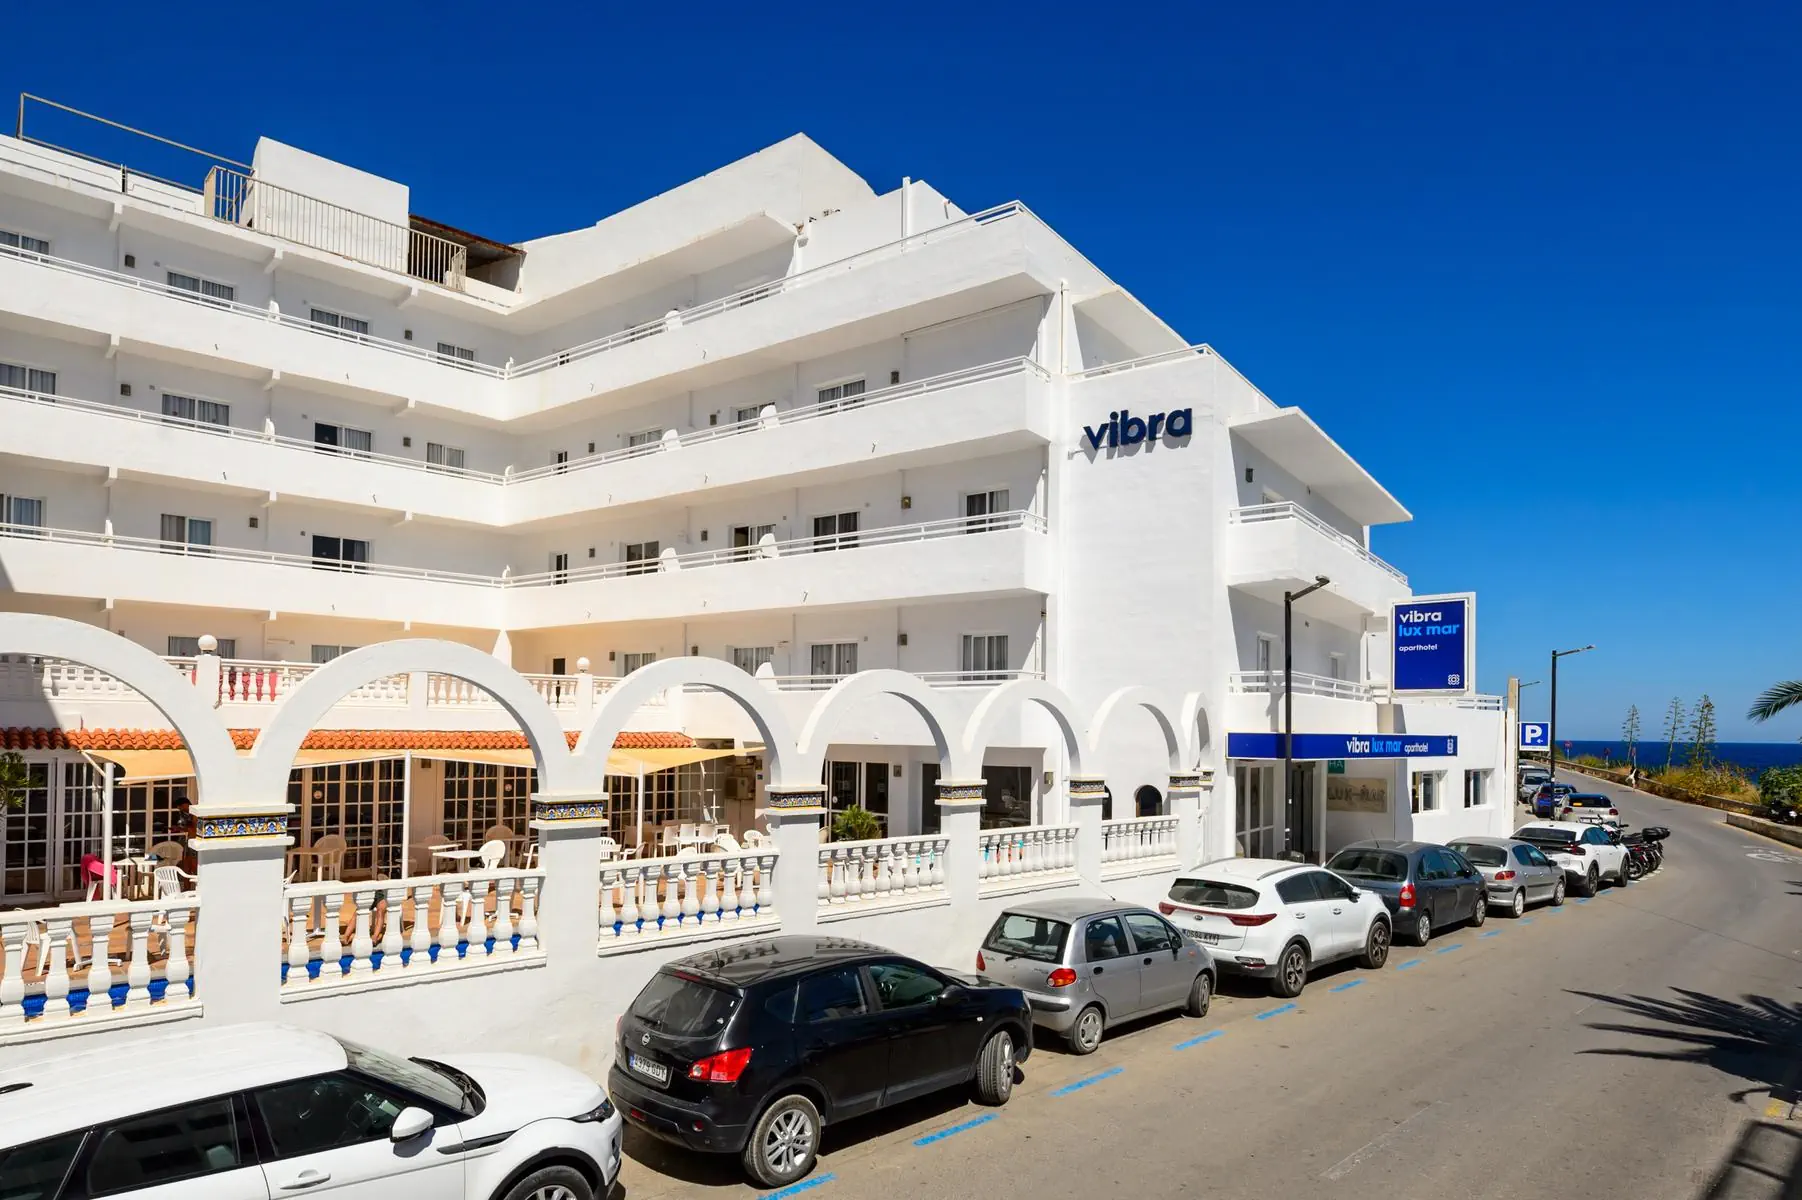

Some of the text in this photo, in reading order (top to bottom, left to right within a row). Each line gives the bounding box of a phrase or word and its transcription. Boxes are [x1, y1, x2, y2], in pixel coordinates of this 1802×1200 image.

[1083, 408, 1192, 451] vibra
[1399, 610, 1442, 623] vibra
[1398, 624, 1460, 637] lux mar
[1398, 644, 1438, 652] aparthotel
[1525, 725, 1542, 743] P
[1346, 737, 1428, 754] vibra lux mar aparthotel
